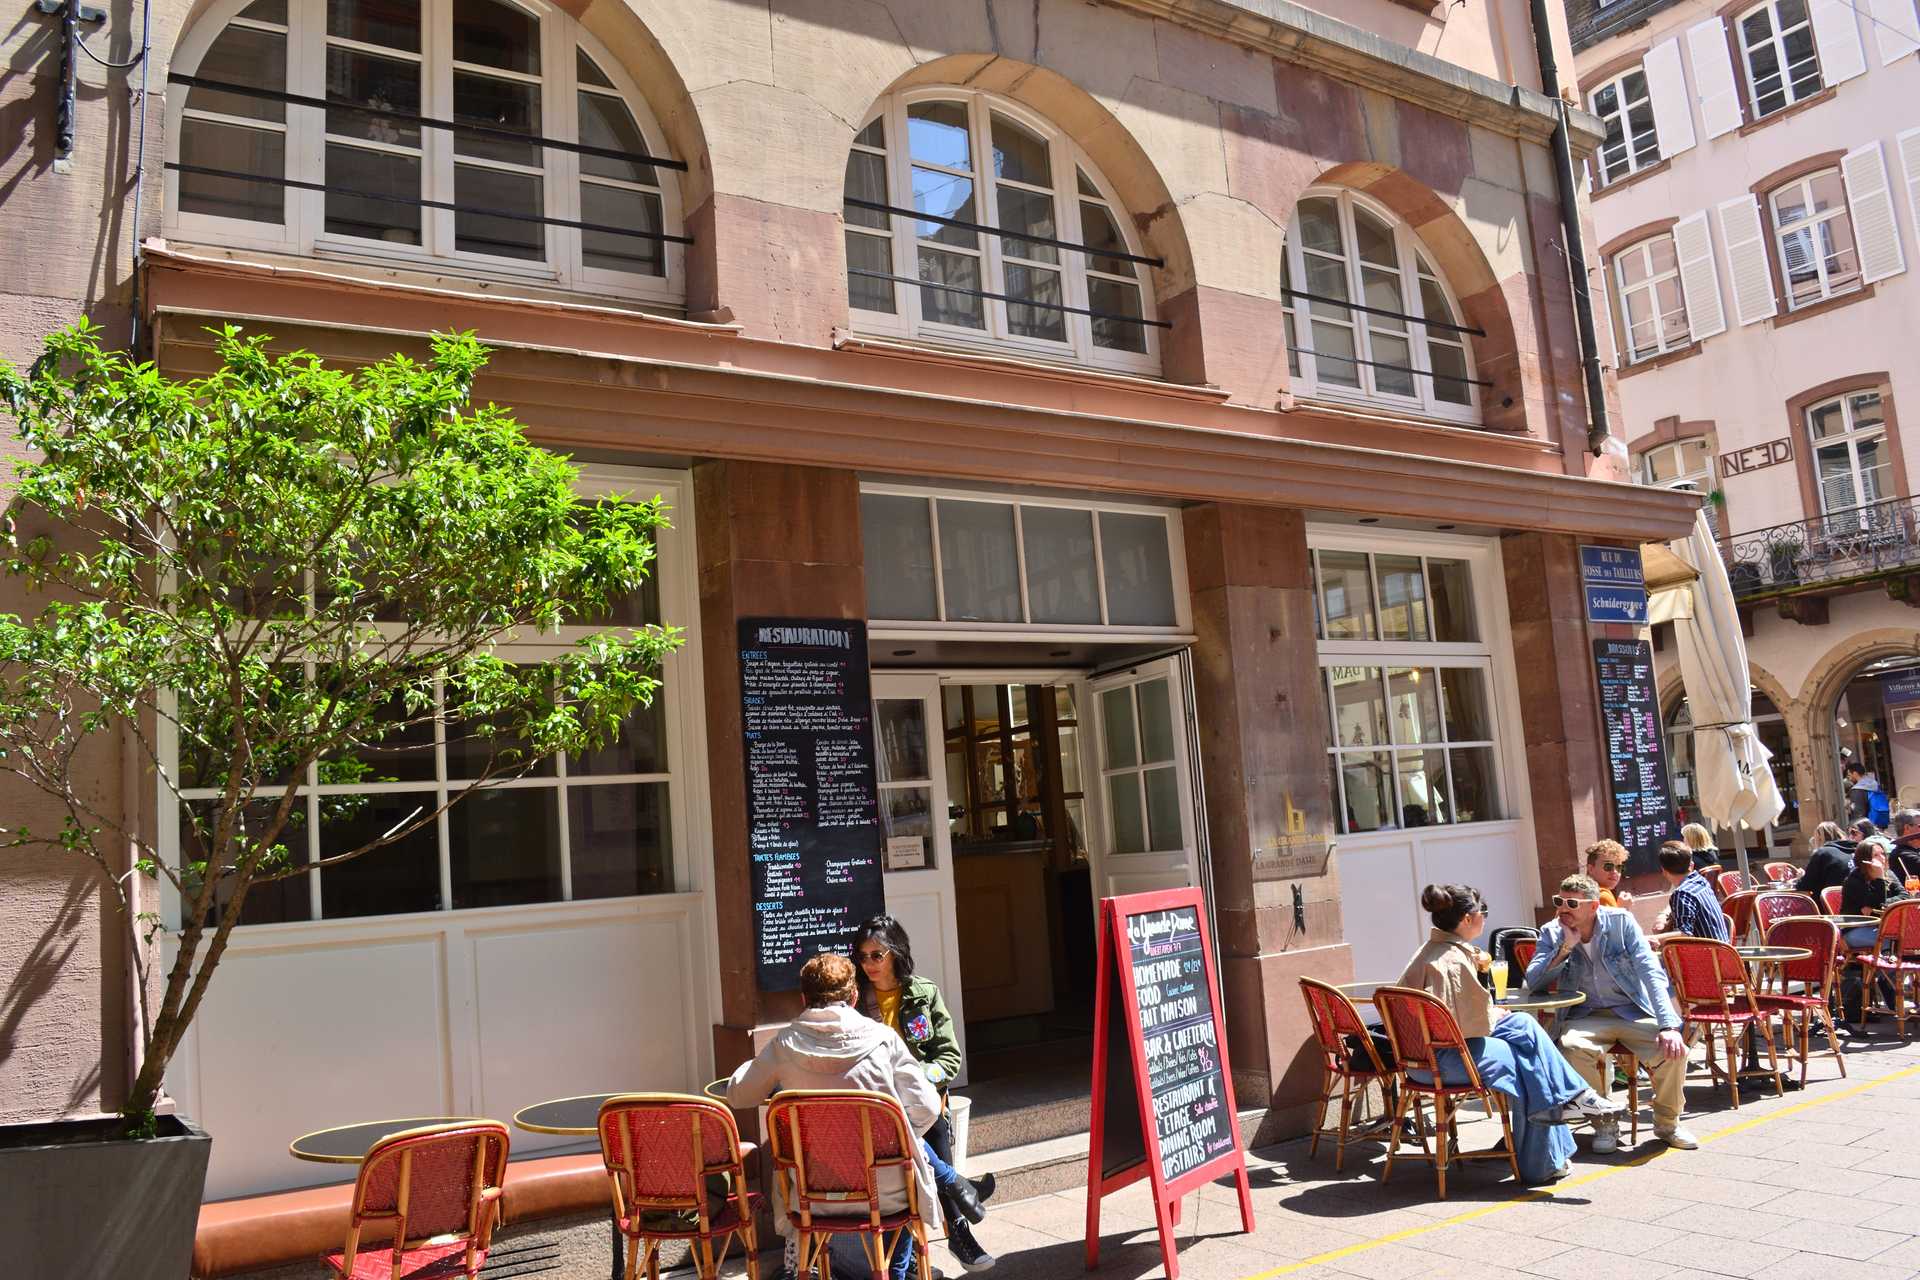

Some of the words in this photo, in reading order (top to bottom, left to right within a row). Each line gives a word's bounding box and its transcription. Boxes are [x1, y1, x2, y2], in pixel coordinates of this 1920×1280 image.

[759, 627, 849, 649] RESTAURATION
[756, 901, 783, 910] DESSERTS
[1169, 912, 1196, 942] Dame
[1133, 959, 1182, 987] HOMEMADE
[1136, 984, 1161, 1009] FOOD
[1139, 1006, 1158, 1029] FAIT
[1160, 996, 1197, 1023] MAISON
[1143, 1036, 1163, 1062] BAR
[1163, 1033, 1173, 1055] &
[1172, 1020, 1216, 1050] CAFETERIA
[1152, 1079, 1204, 1120] RESTAURANT
[1158, 1127, 1190, 1159] DINING
[1190, 1115, 1217, 1144] ROOM
[1162, 1139, 1206, 1180] UPSTAIRS
